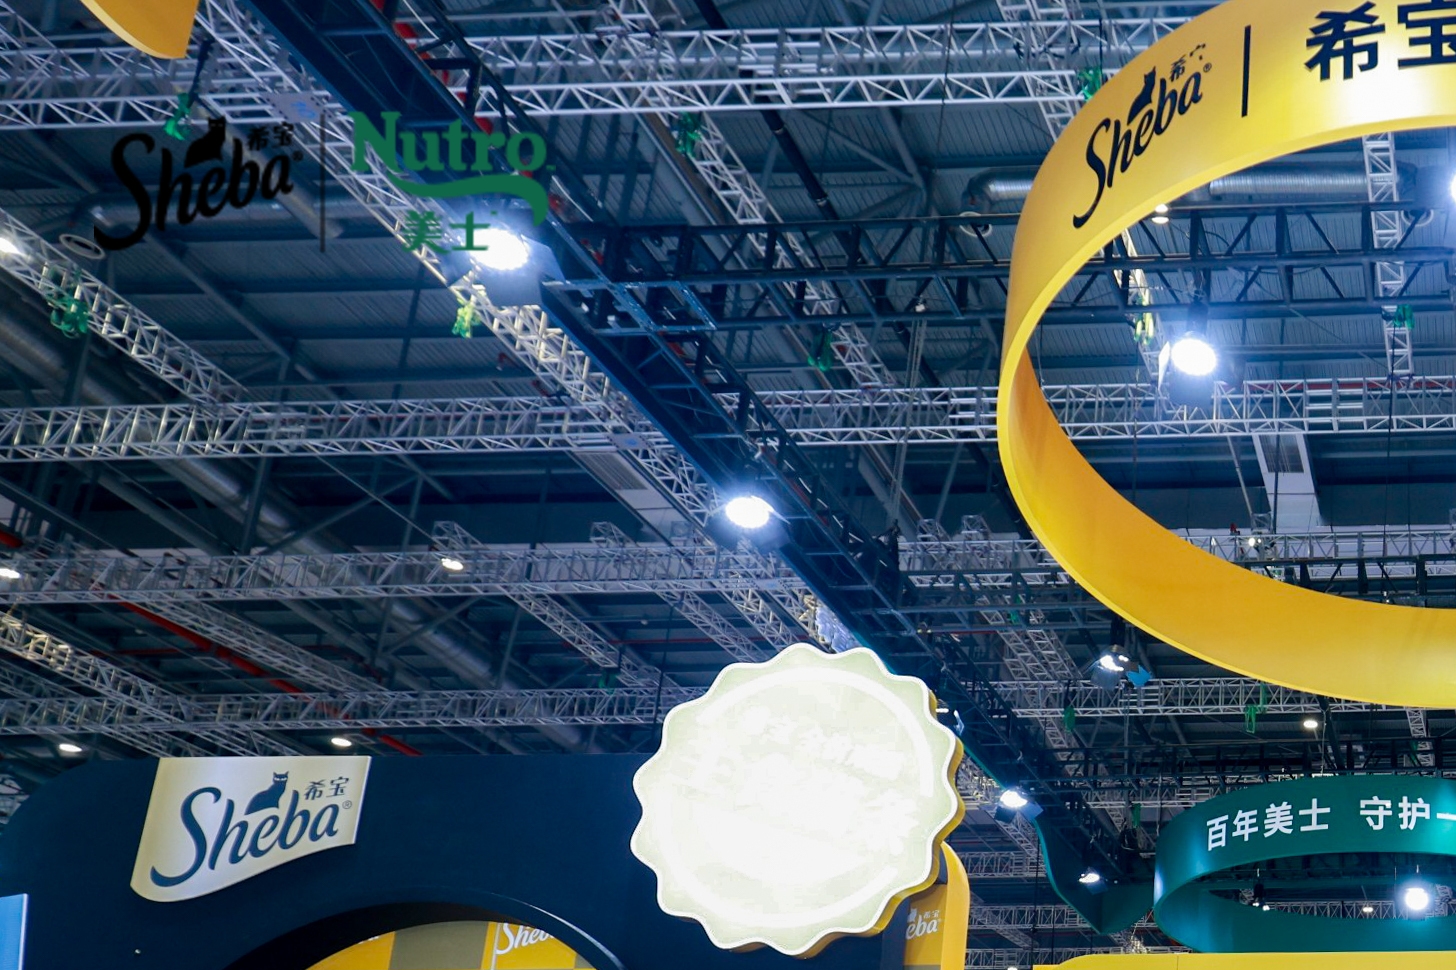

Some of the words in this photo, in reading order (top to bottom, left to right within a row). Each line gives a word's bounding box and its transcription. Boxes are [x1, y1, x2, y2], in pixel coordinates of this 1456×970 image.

[1072, 75, 1205, 229] Sheba
[304, 776, 350, 801] 希宝
[1206, 798, 1331, 852] 百年美士
[150, 786, 339, 888] Sheba
